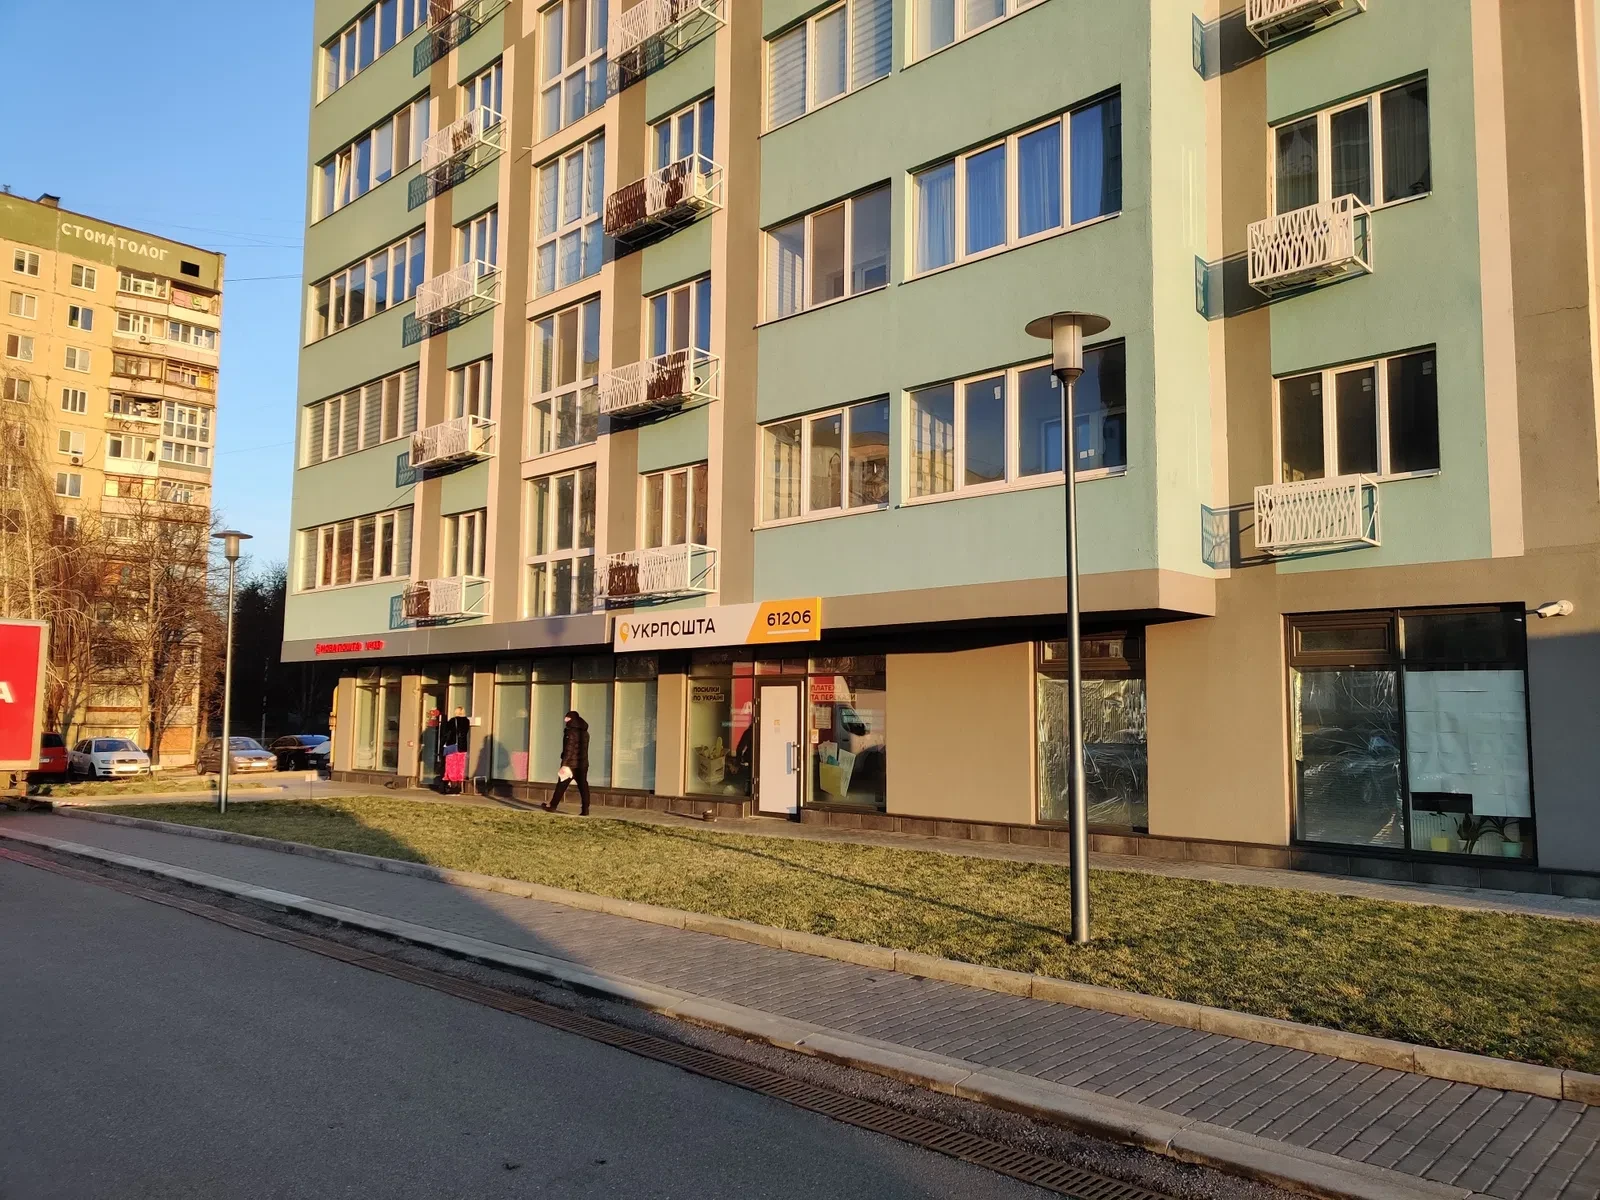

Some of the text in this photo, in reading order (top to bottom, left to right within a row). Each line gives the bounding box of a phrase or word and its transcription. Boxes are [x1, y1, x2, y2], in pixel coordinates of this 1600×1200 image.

[61, 222, 169, 261] СТОМАТОЛОГ
[631, 618, 716, 639] УКРПОШТА
[767, 610, 811, 626] 61206
